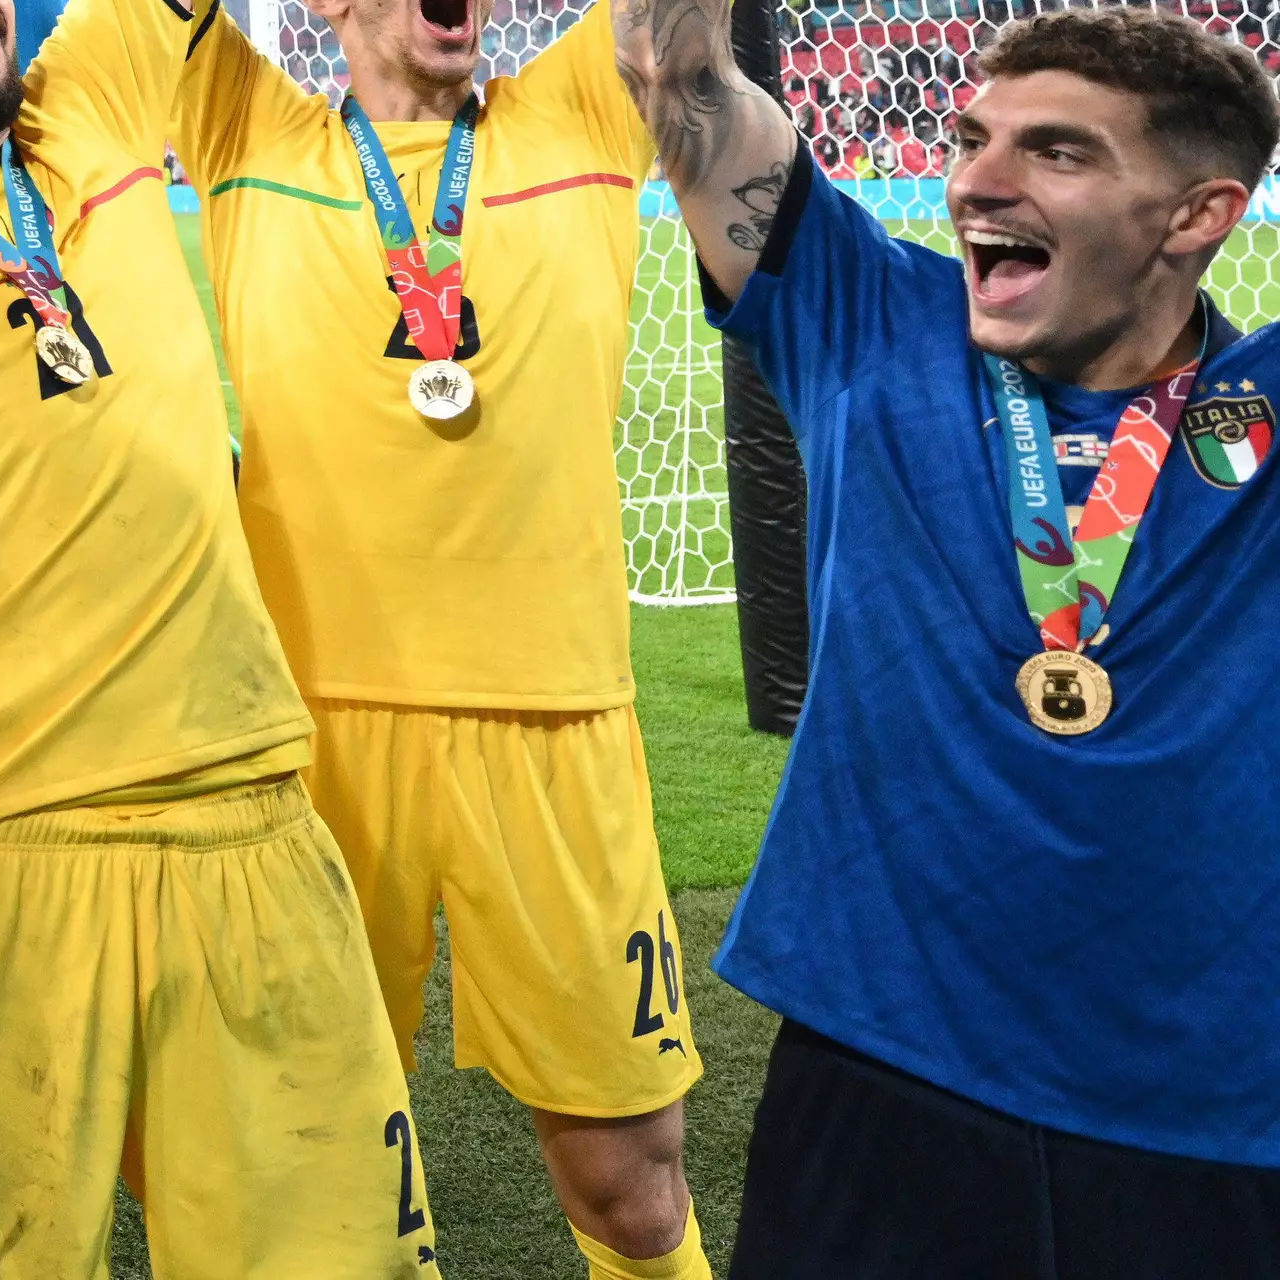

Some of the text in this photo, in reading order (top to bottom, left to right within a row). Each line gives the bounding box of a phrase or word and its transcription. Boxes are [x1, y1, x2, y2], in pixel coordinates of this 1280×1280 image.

[456, 129, 475, 163] EURO
[348, 117, 396, 211] UEFA EURO 2020
[13, 183, 35, 213] EURO
[448, 166, 469, 198] UEFA
[21, 213, 42, 249] UEFA
[1007, 398, 1037, 452] EURO
[1186, 403, 1262, 428] ITALIA
[1019, 454, 1048, 508] UEFA
[1024, 653, 1097, 674] UEFA EURO 2020
[626, 909, 681, 1039] 26
